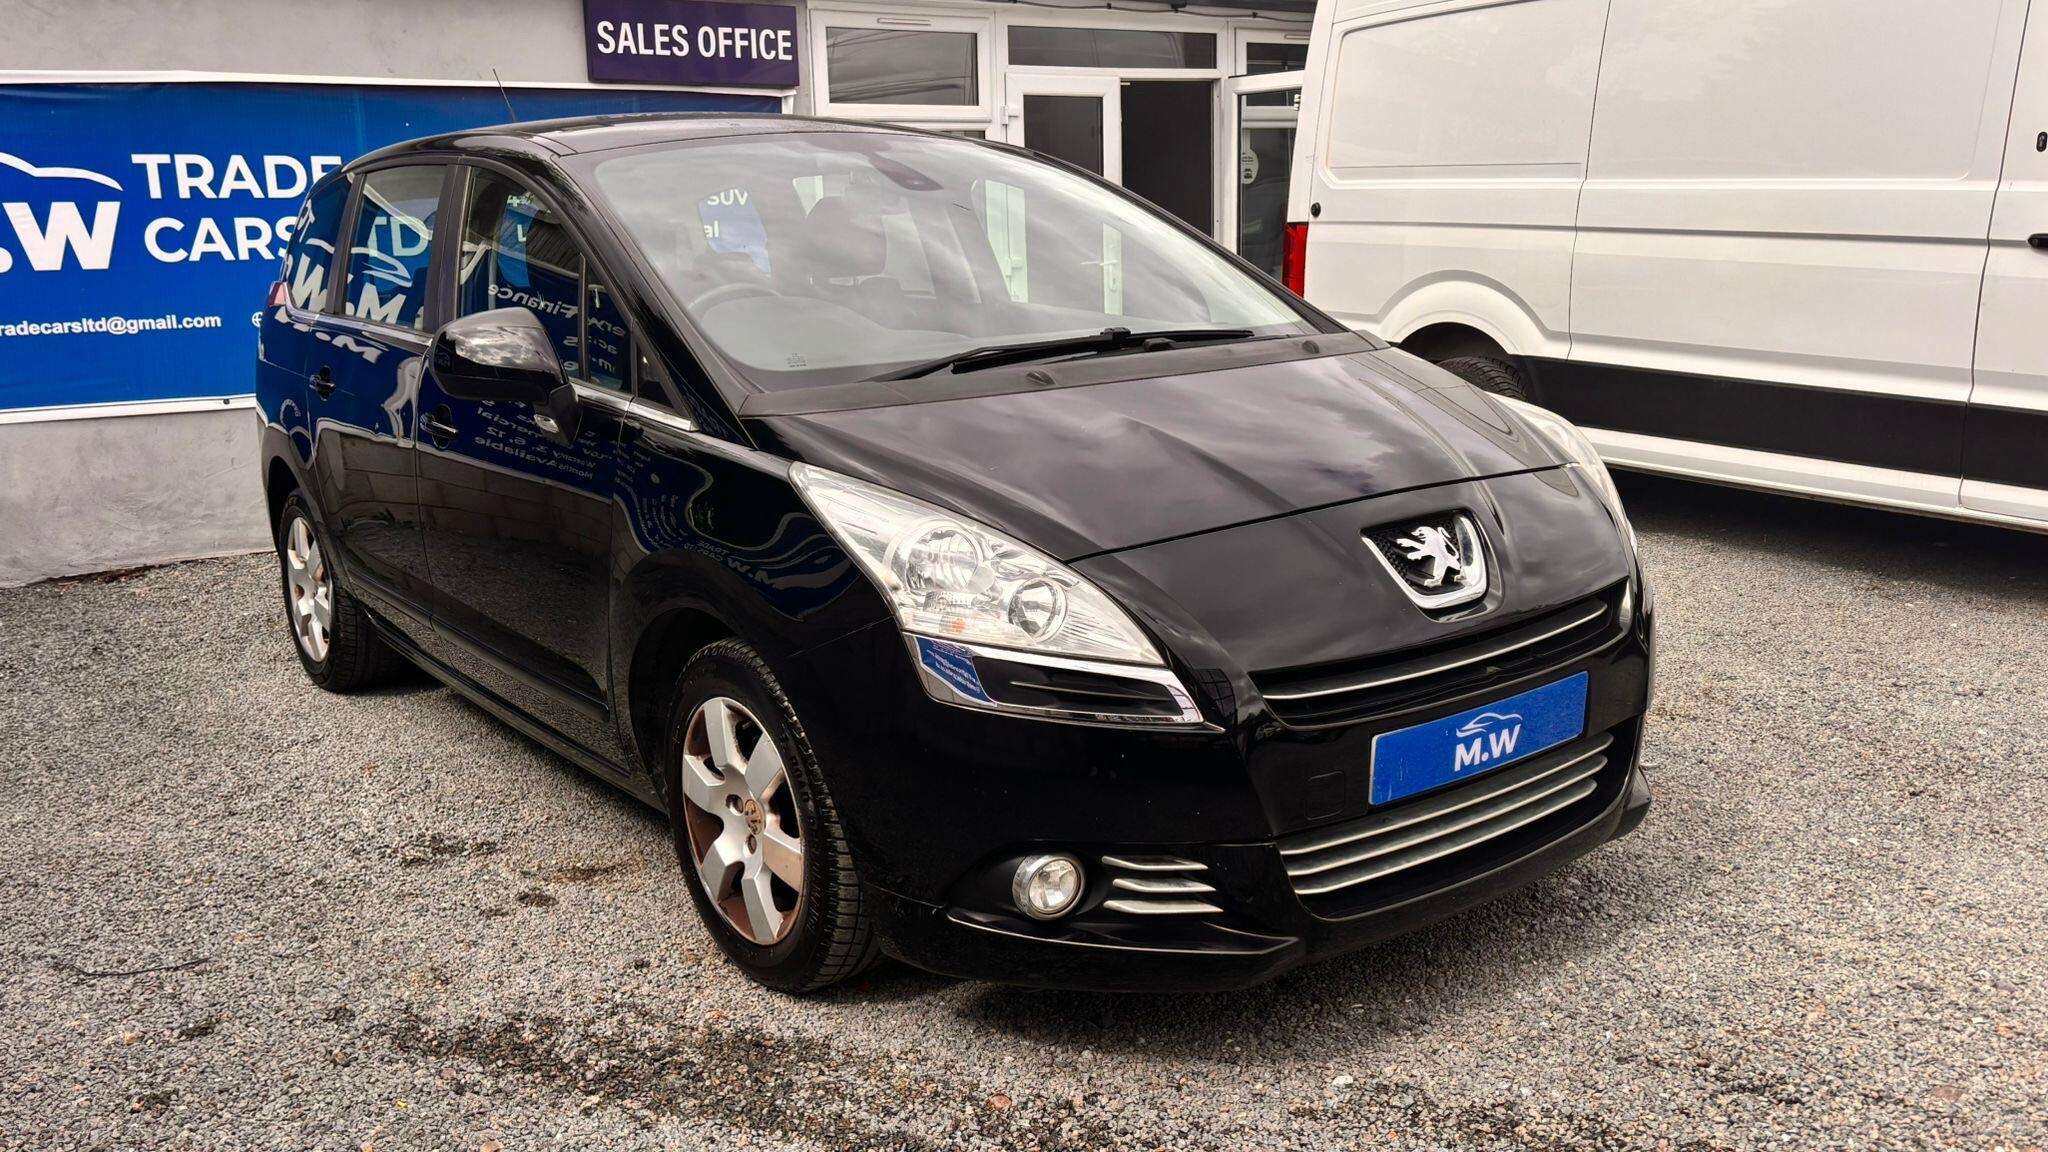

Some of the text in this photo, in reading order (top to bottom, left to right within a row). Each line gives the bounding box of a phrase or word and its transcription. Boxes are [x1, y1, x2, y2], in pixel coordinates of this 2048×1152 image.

[597, 20, 793, 61] SALES OFFICE
[1454, 723, 1522, 773] M.W
